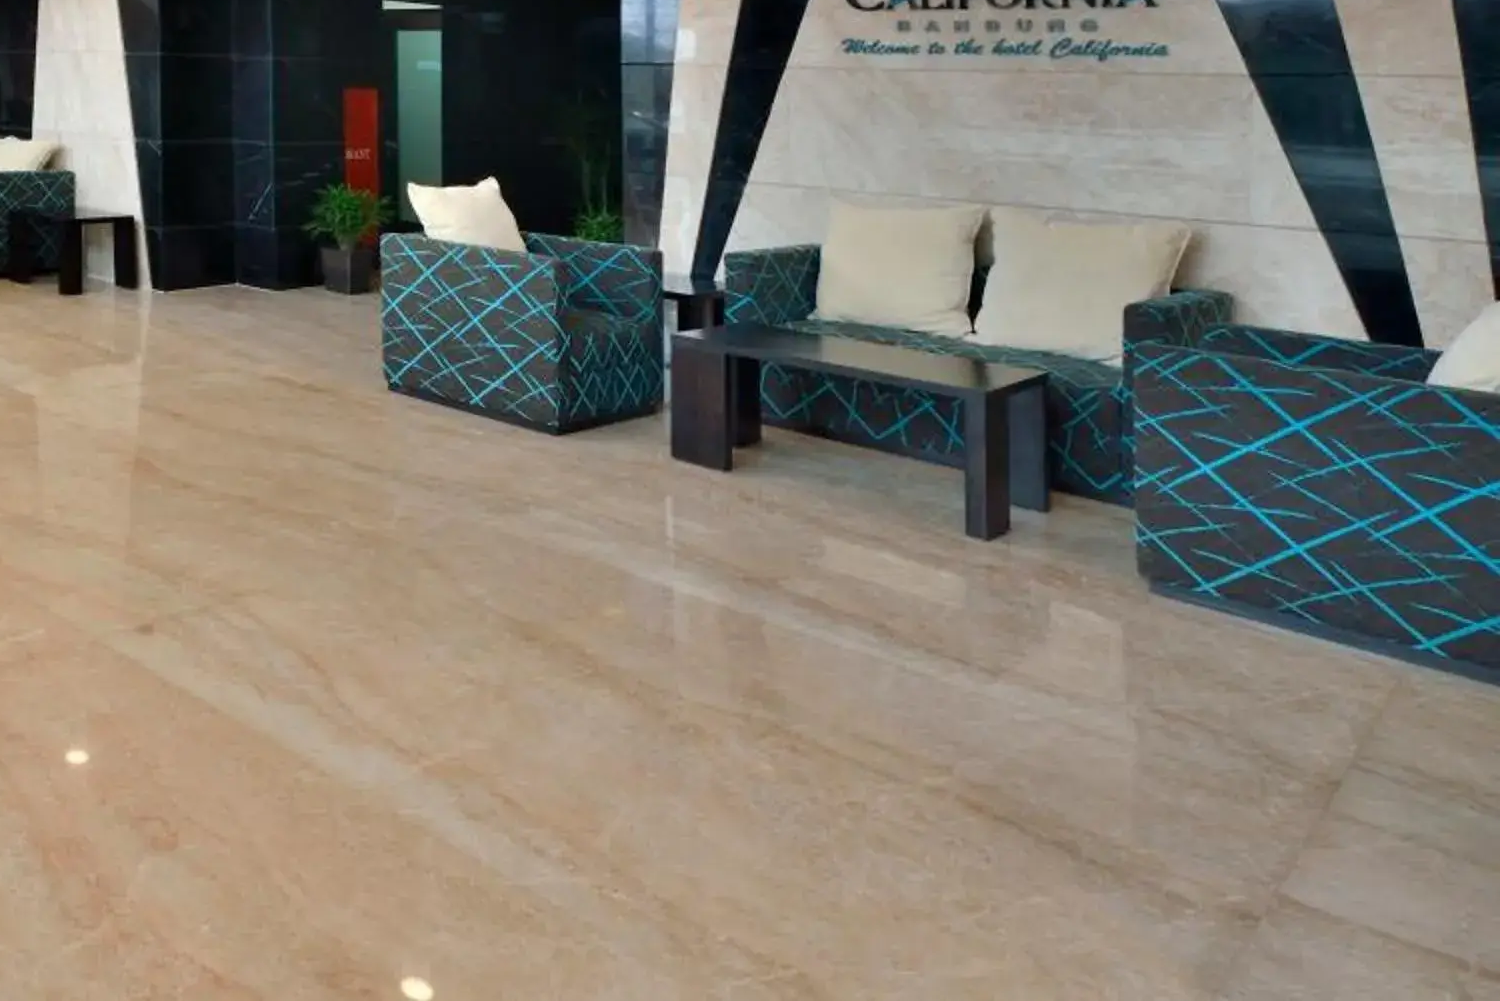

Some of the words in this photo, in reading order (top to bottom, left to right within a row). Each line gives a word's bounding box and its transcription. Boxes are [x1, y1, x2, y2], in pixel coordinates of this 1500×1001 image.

[841, 37, 921, 55] Welcome
[927, 41, 946, 56] to
[954, 35, 985, 55] the
[991, 37, 1043, 56] hotel
[1050, 36, 1169, 62] California
